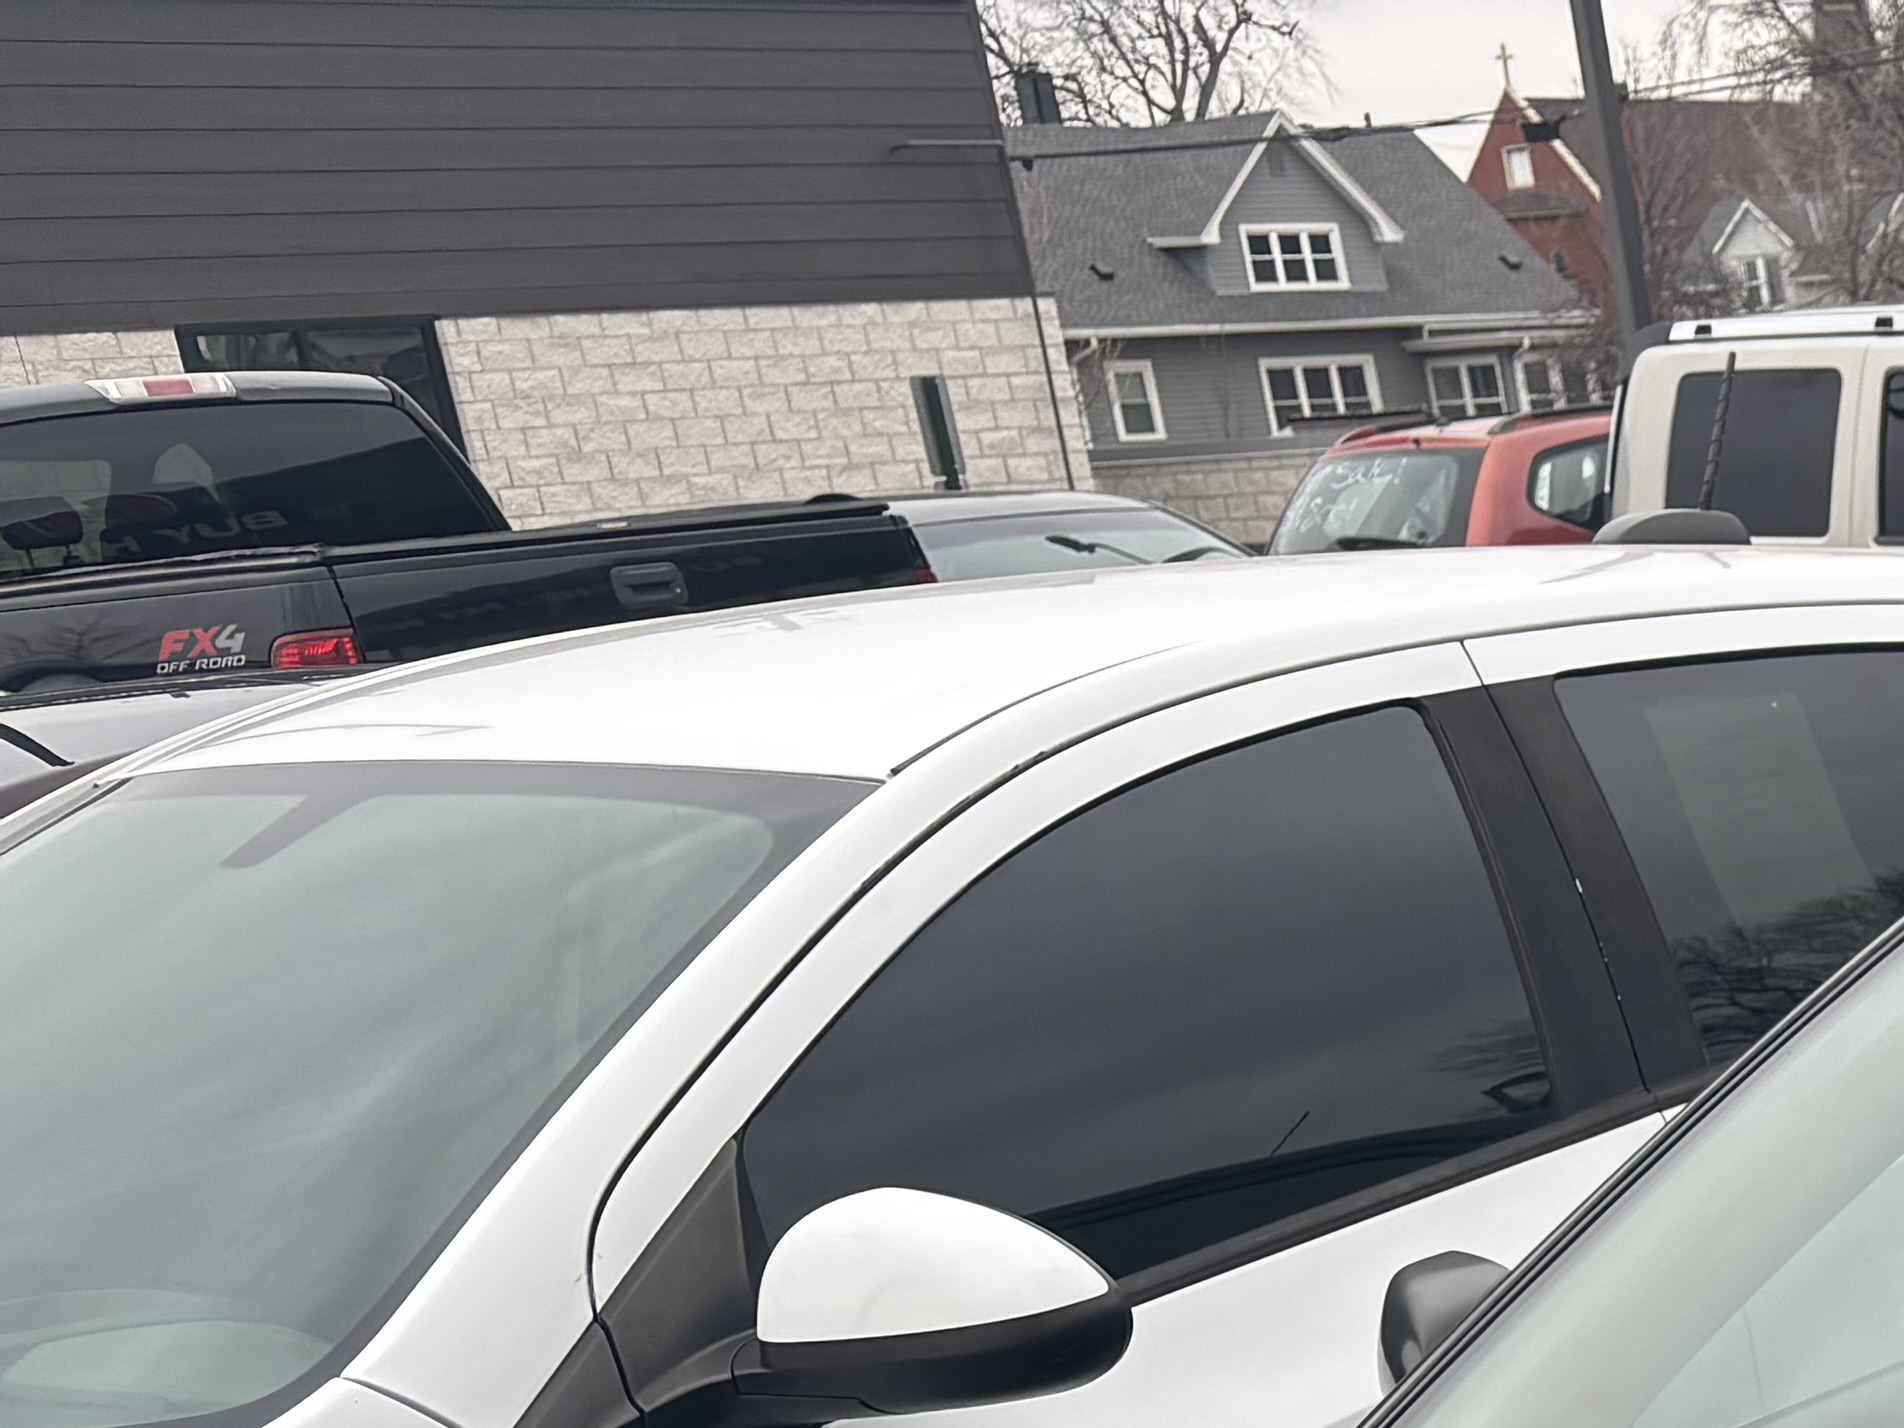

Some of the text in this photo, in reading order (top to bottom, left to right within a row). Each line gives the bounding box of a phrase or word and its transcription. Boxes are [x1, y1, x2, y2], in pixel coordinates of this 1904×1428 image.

[159, 623, 246, 661] FX4
[156, 654, 246, 674] OFF ROAD
